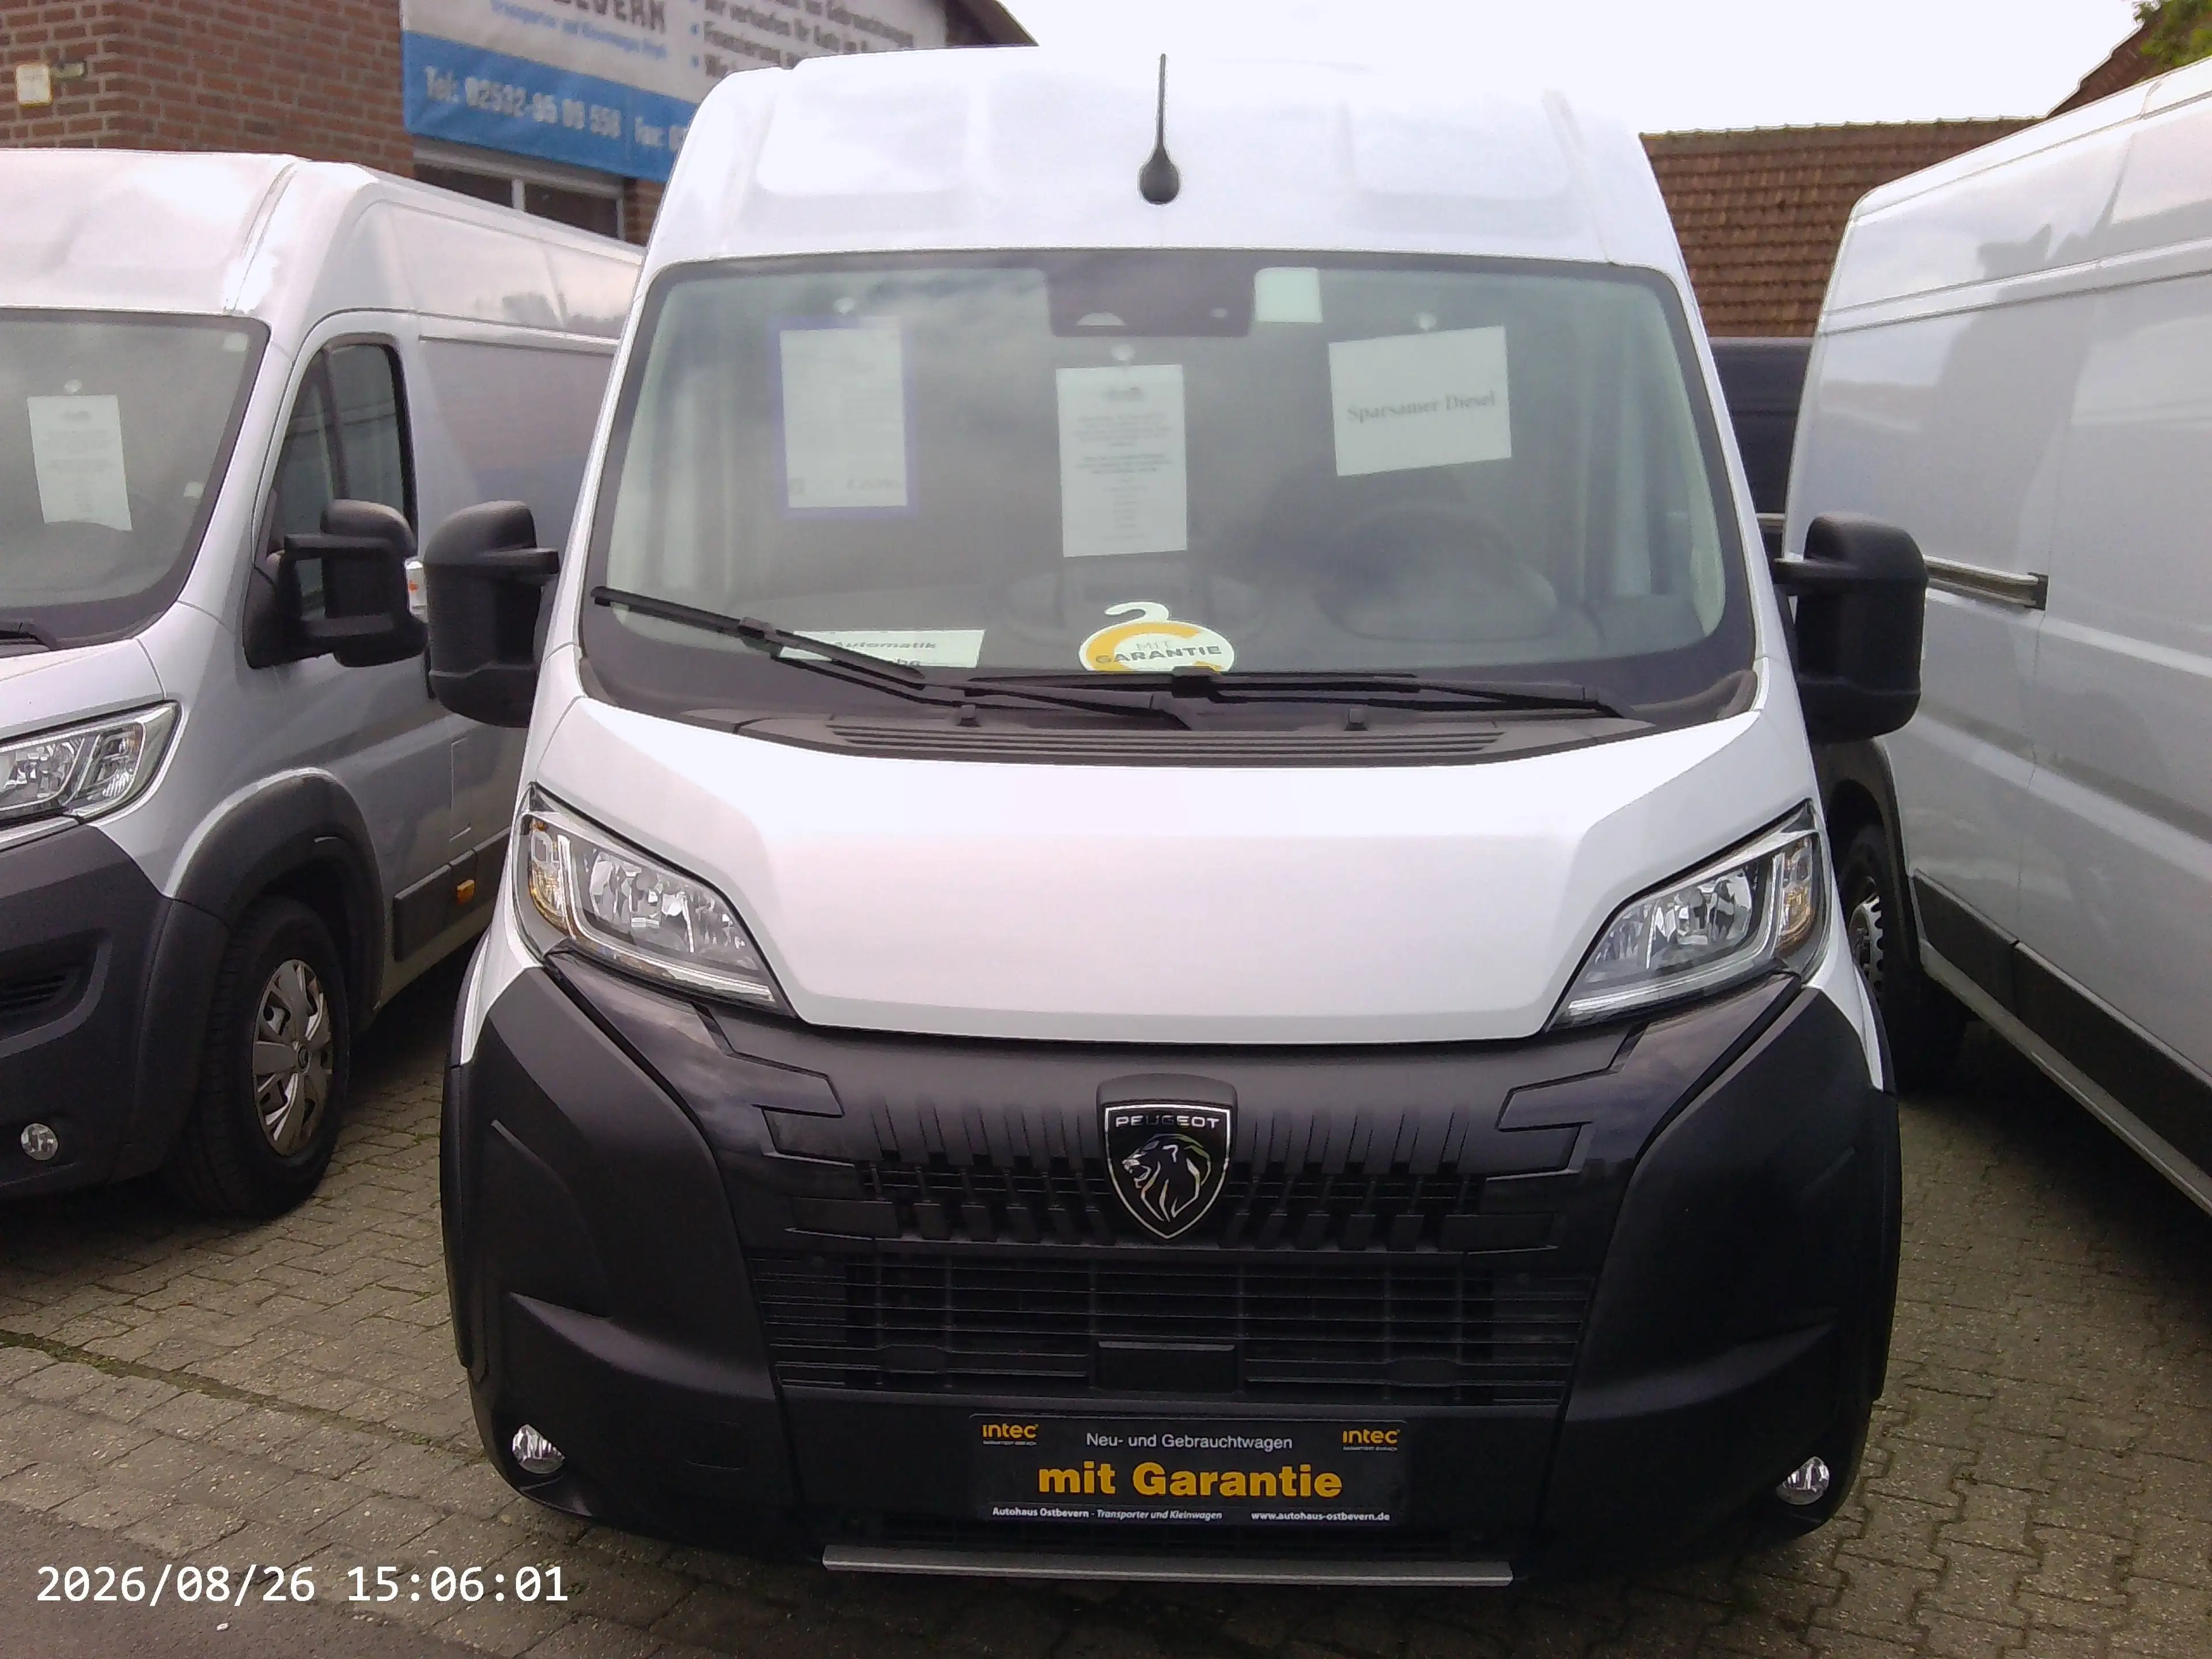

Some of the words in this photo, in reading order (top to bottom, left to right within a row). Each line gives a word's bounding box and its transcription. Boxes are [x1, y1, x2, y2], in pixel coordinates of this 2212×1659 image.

[1096, 645, 1222, 663] GARANTIE
[1116, 1115, 1219, 1129] PEUGEOT
[1086, 1433, 1124, 1446] Neu-
[1128, 1434, 1157, 1447] und
[1161, 1434, 1293, 1452] Gebrauchtwagen
[1039, 1461, 1115, 1494] mit
[1132, 1462, 1342, 1498] Garantie
[993, 1507, 1037, 1516] Autohaus
[1040, 1508, 1089, 1517] Ostbevern
[1097, 1509, 1149, 1520] Transporter
[1151, 1510, 1168, 1518] und
[1169, 1510, 1222, 1521] Kleinwagen
